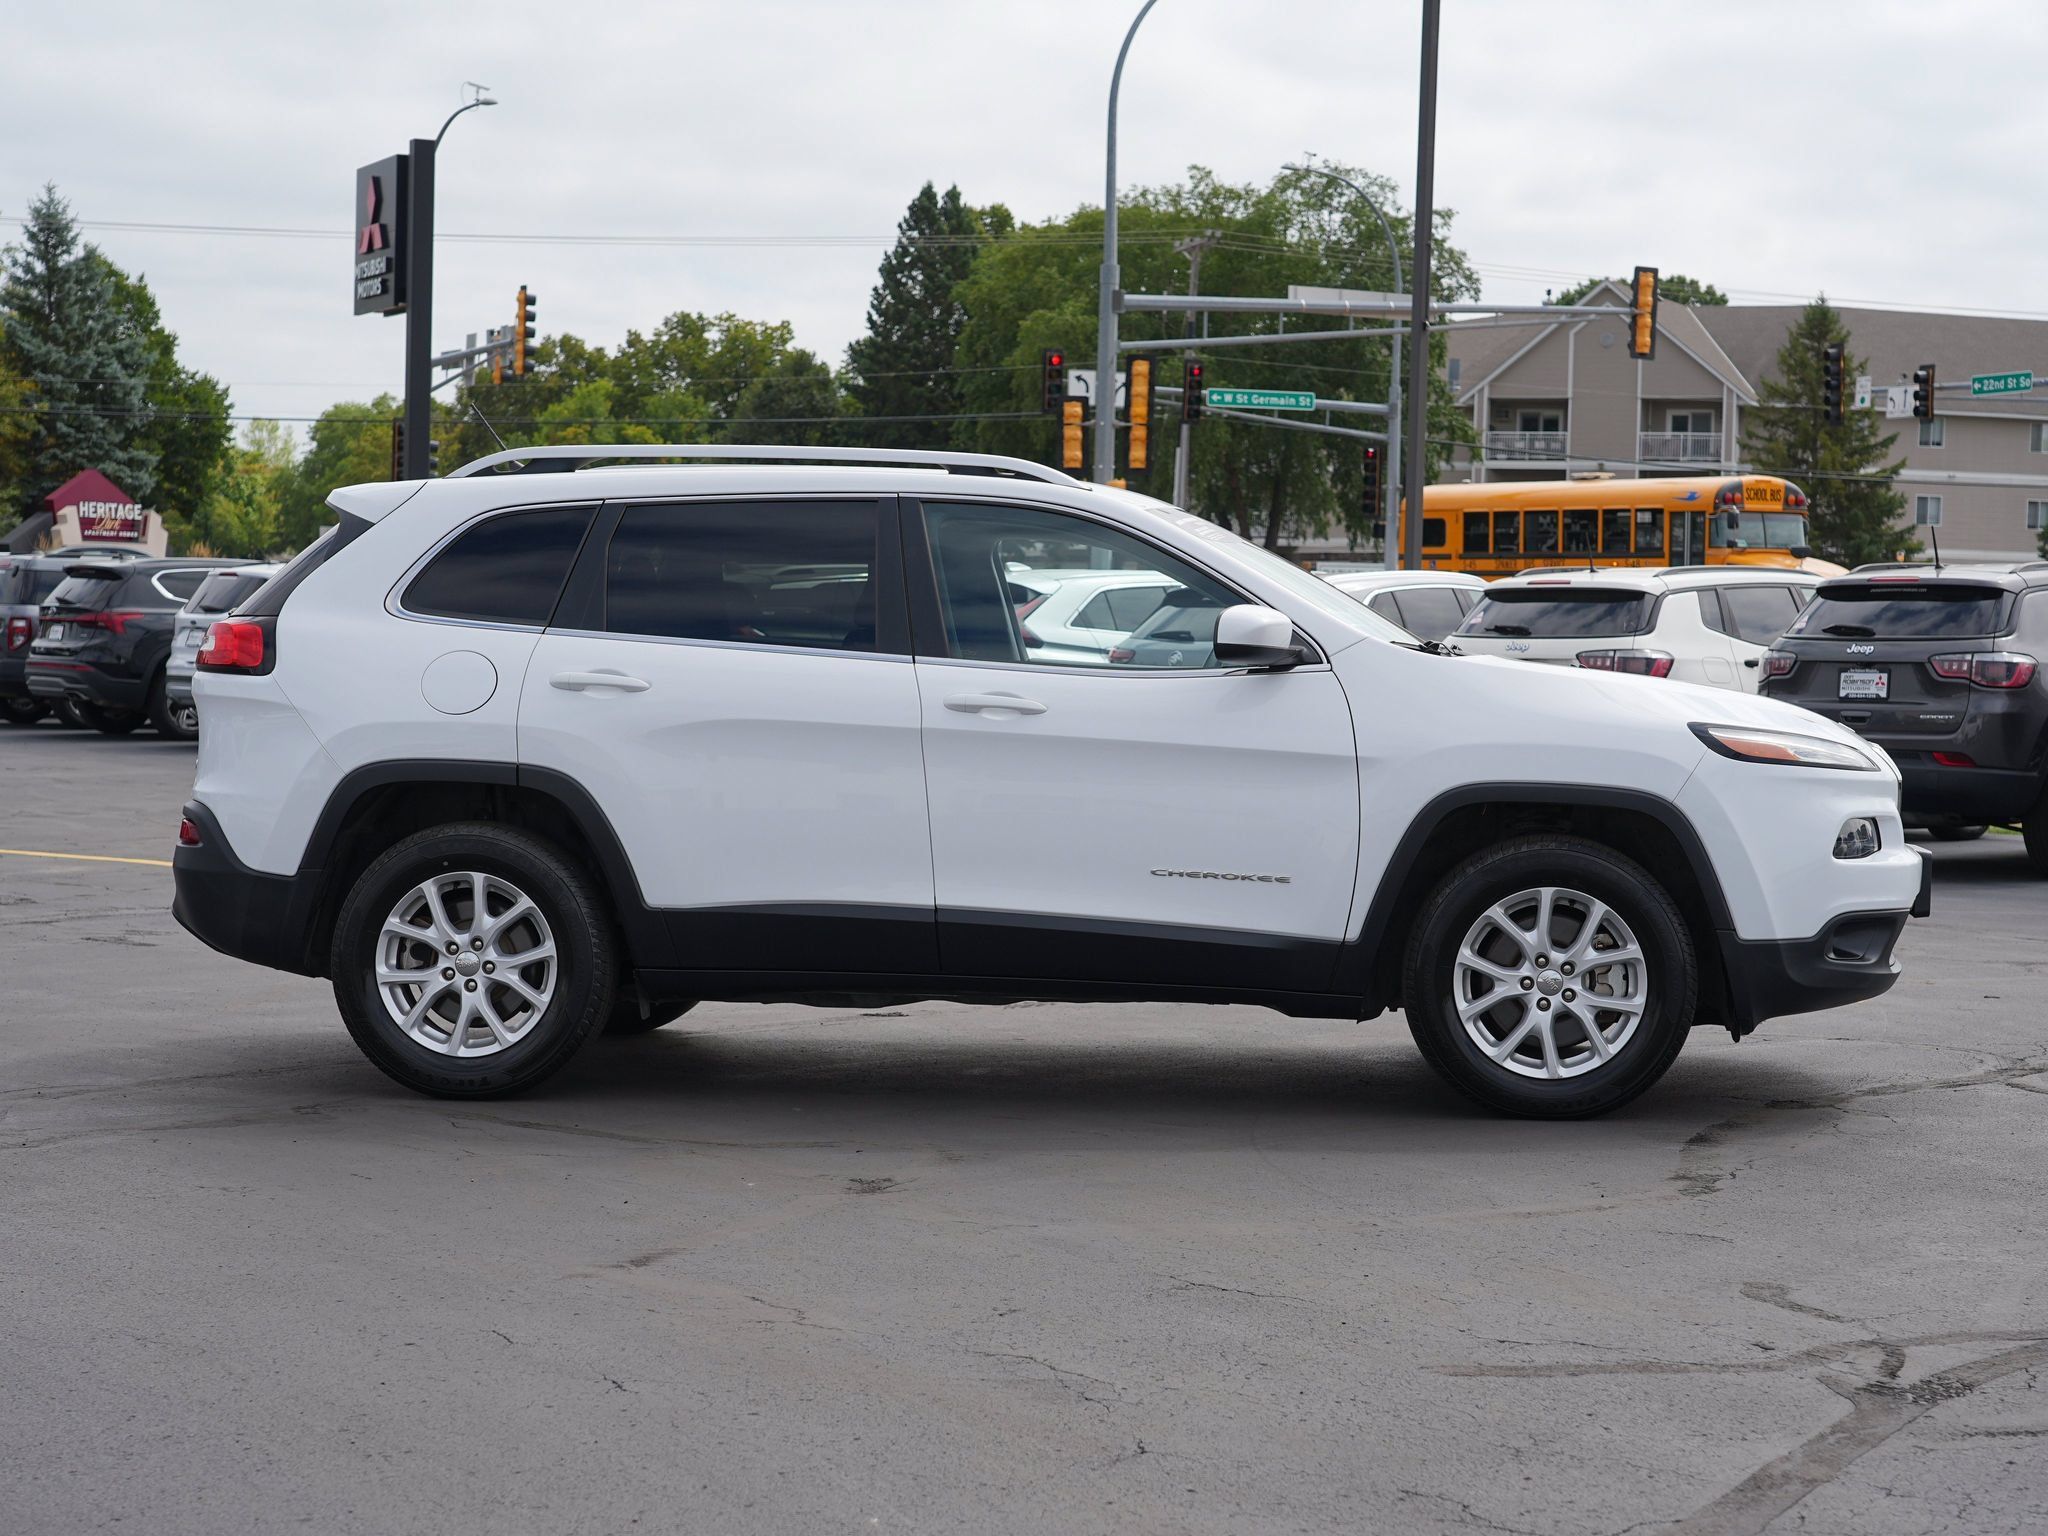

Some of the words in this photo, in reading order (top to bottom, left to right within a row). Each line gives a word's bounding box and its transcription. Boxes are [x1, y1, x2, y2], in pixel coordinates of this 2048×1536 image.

[355, 256, 386, 280] MITSUBISHI
[357, 277, 382, 300] MOTORS
[1983, 379, 2005, 391] 22nd
[2007, 377, 2017, 389] St
[1223, 393, 1234, 403] W
[1236, 394, 1249, 403] St
[1251, 394, 1297, 405] Germain
[1299, 396, 1311, 406] St
[1745, 487, 1768, 502] SCHOOL
[1769, 488, 1782, 502] BUS
[79, 501, 143, 520] HERITAGE
[1846, 643, 1875, 655] Jeep
[1150, 868, 1292, 884] CHEROKEE
